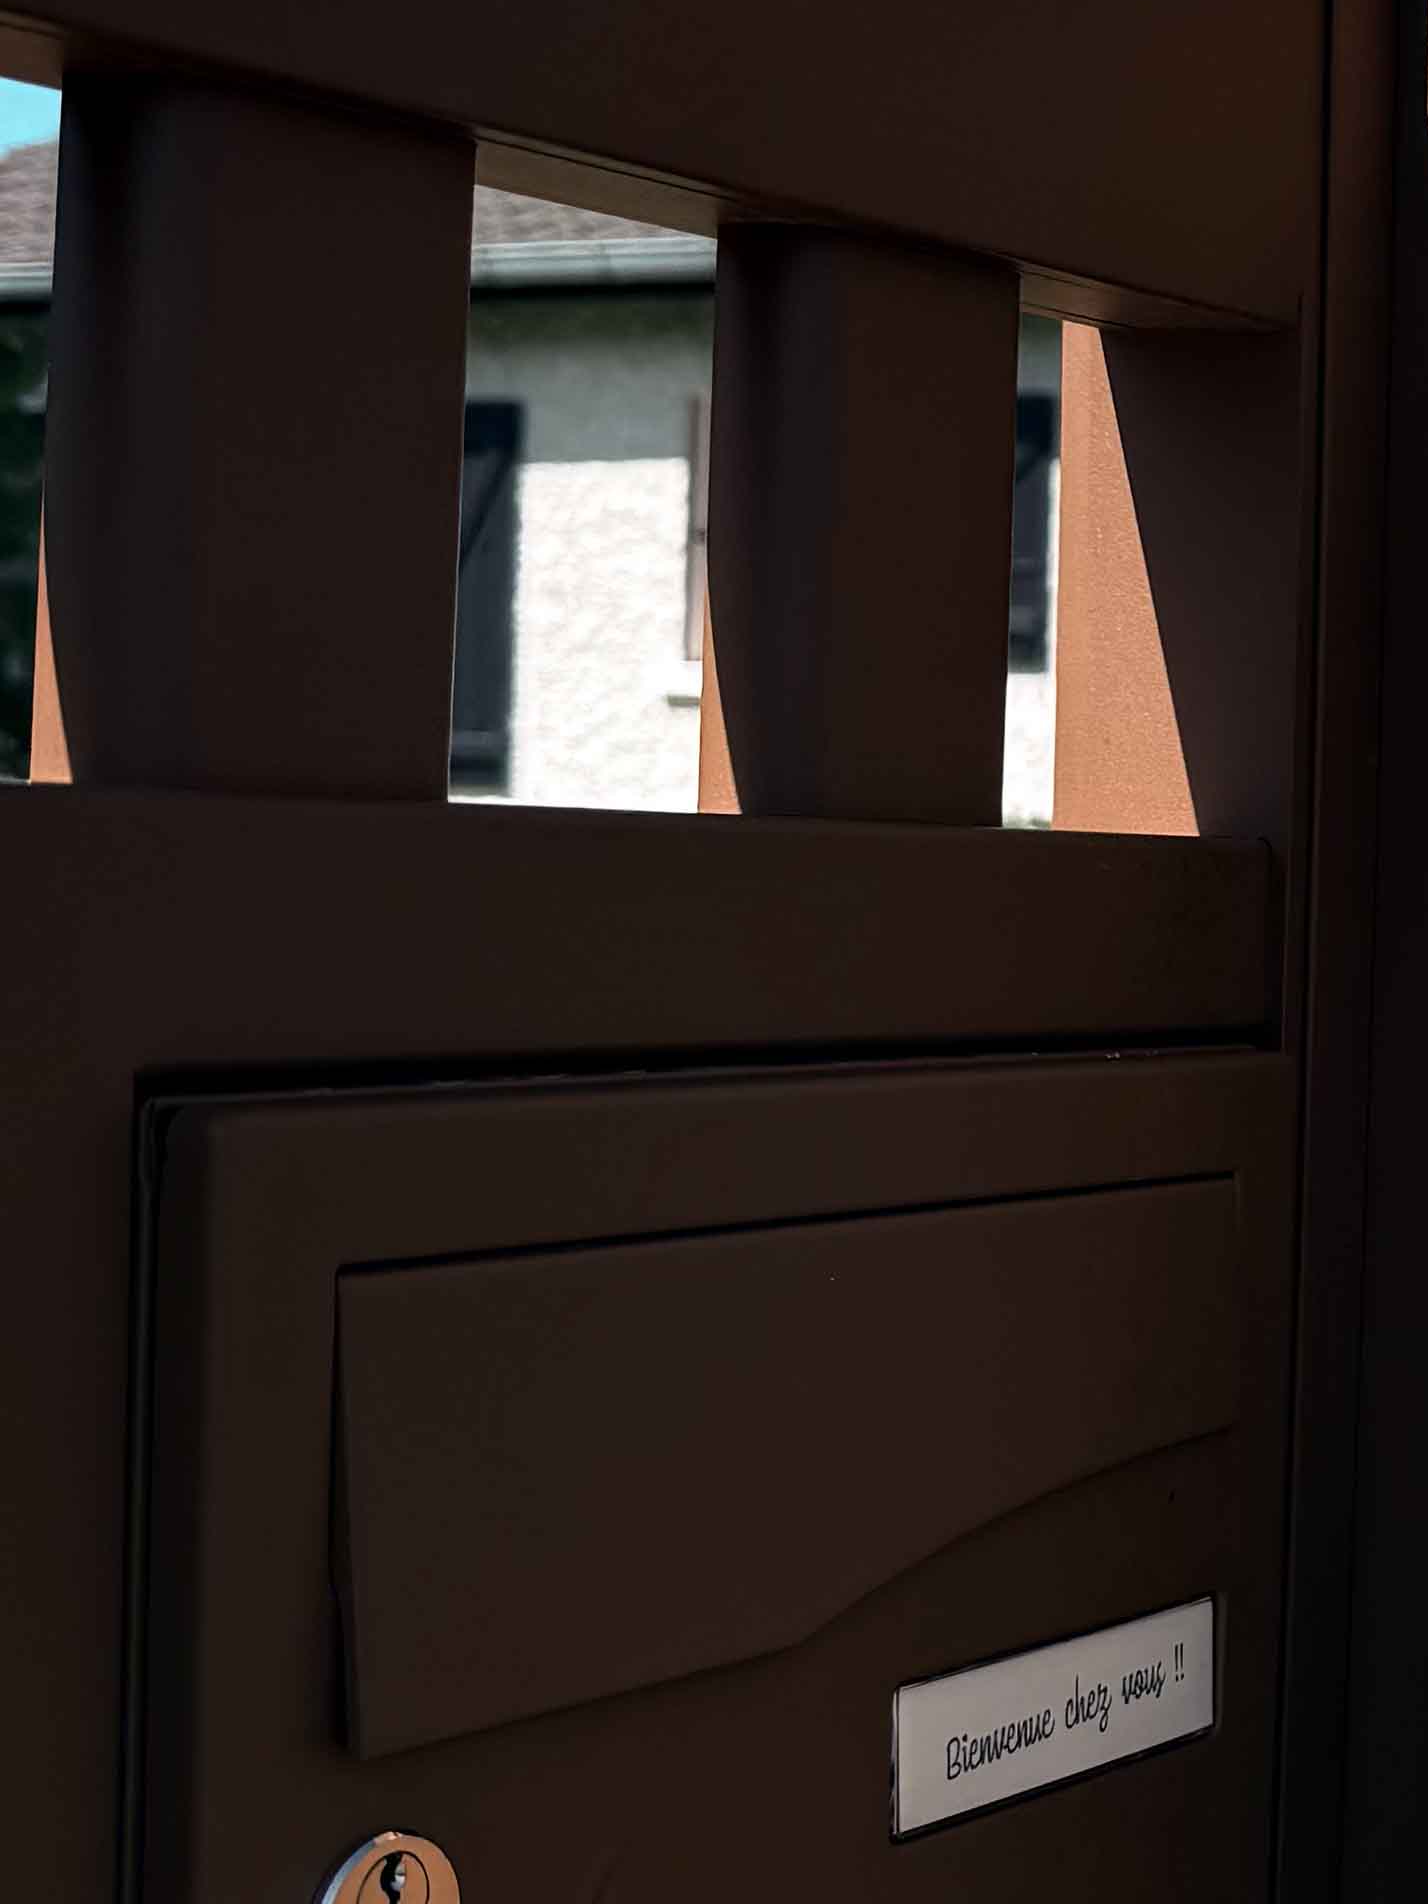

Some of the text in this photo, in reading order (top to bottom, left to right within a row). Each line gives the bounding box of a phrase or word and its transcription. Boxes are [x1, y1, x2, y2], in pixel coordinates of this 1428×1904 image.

[946, 1708, 1055, 1780] Bienvenue
[1064, 1674, 1112, 1732] chez
[1121, 1660, 1166, 1705] vous
